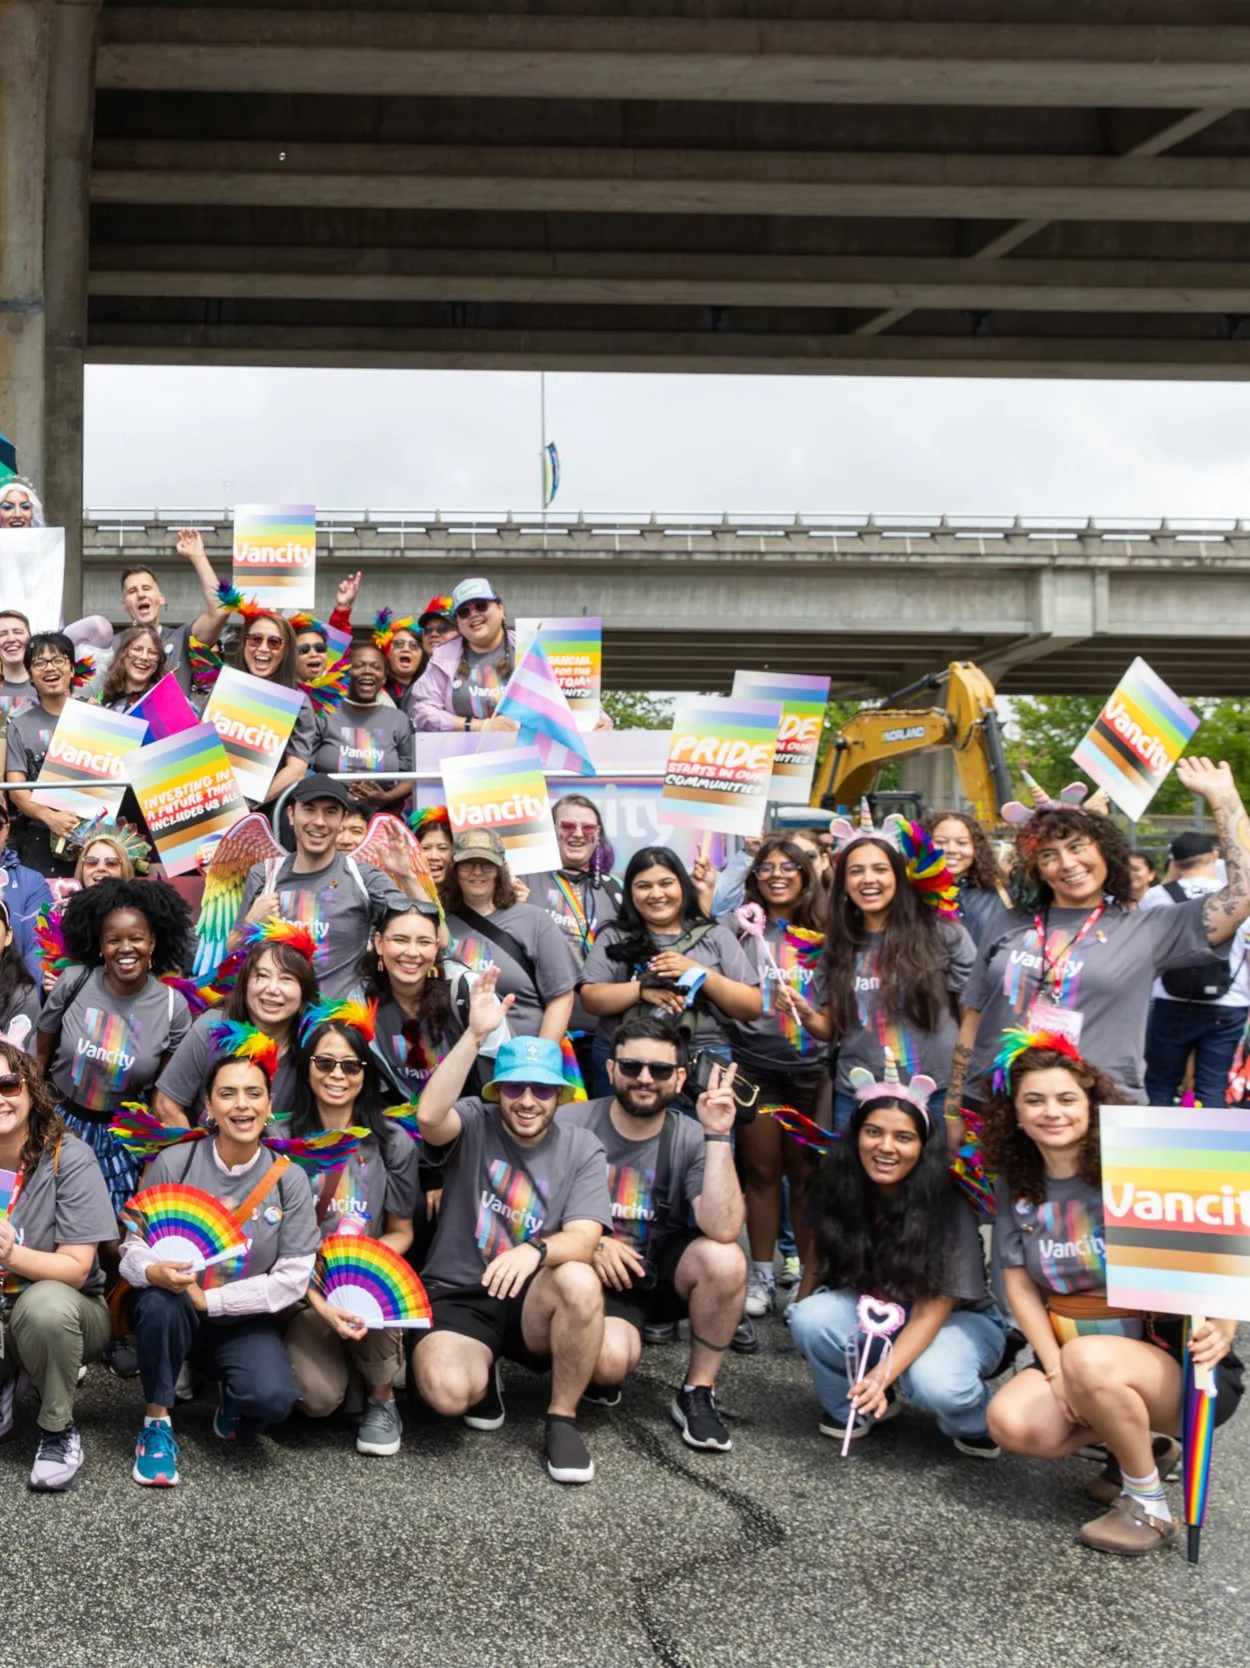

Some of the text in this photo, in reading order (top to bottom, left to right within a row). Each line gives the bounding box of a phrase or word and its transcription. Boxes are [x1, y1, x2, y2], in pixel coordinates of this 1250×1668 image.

[233, 543, 316, 568] Vancity
[340, 745, 384, 762] Vancity
[671, 735, 773, 769] PRIDE
[1104, 697, 1175, 781] Vancity
[664, 774, 763, 795] COMMUNITIES
[667, 762, 765, 782] STARTS IN OUR
[143, 769, 230, 811] INVESTING IN
[147, 780, 235, 820] A FUTURE THAT
[151, 793, 238, 832] INCLUDES US ALL
[448, 793, 550, 827] Vancity
[77, 1037, 136, 1072] Vancity
[481, 1190, 544, 1234] Vancity
[1103, 1180, 1250, 1227] Vancit
[1038, 1235, 1106, 1260] Vancity
